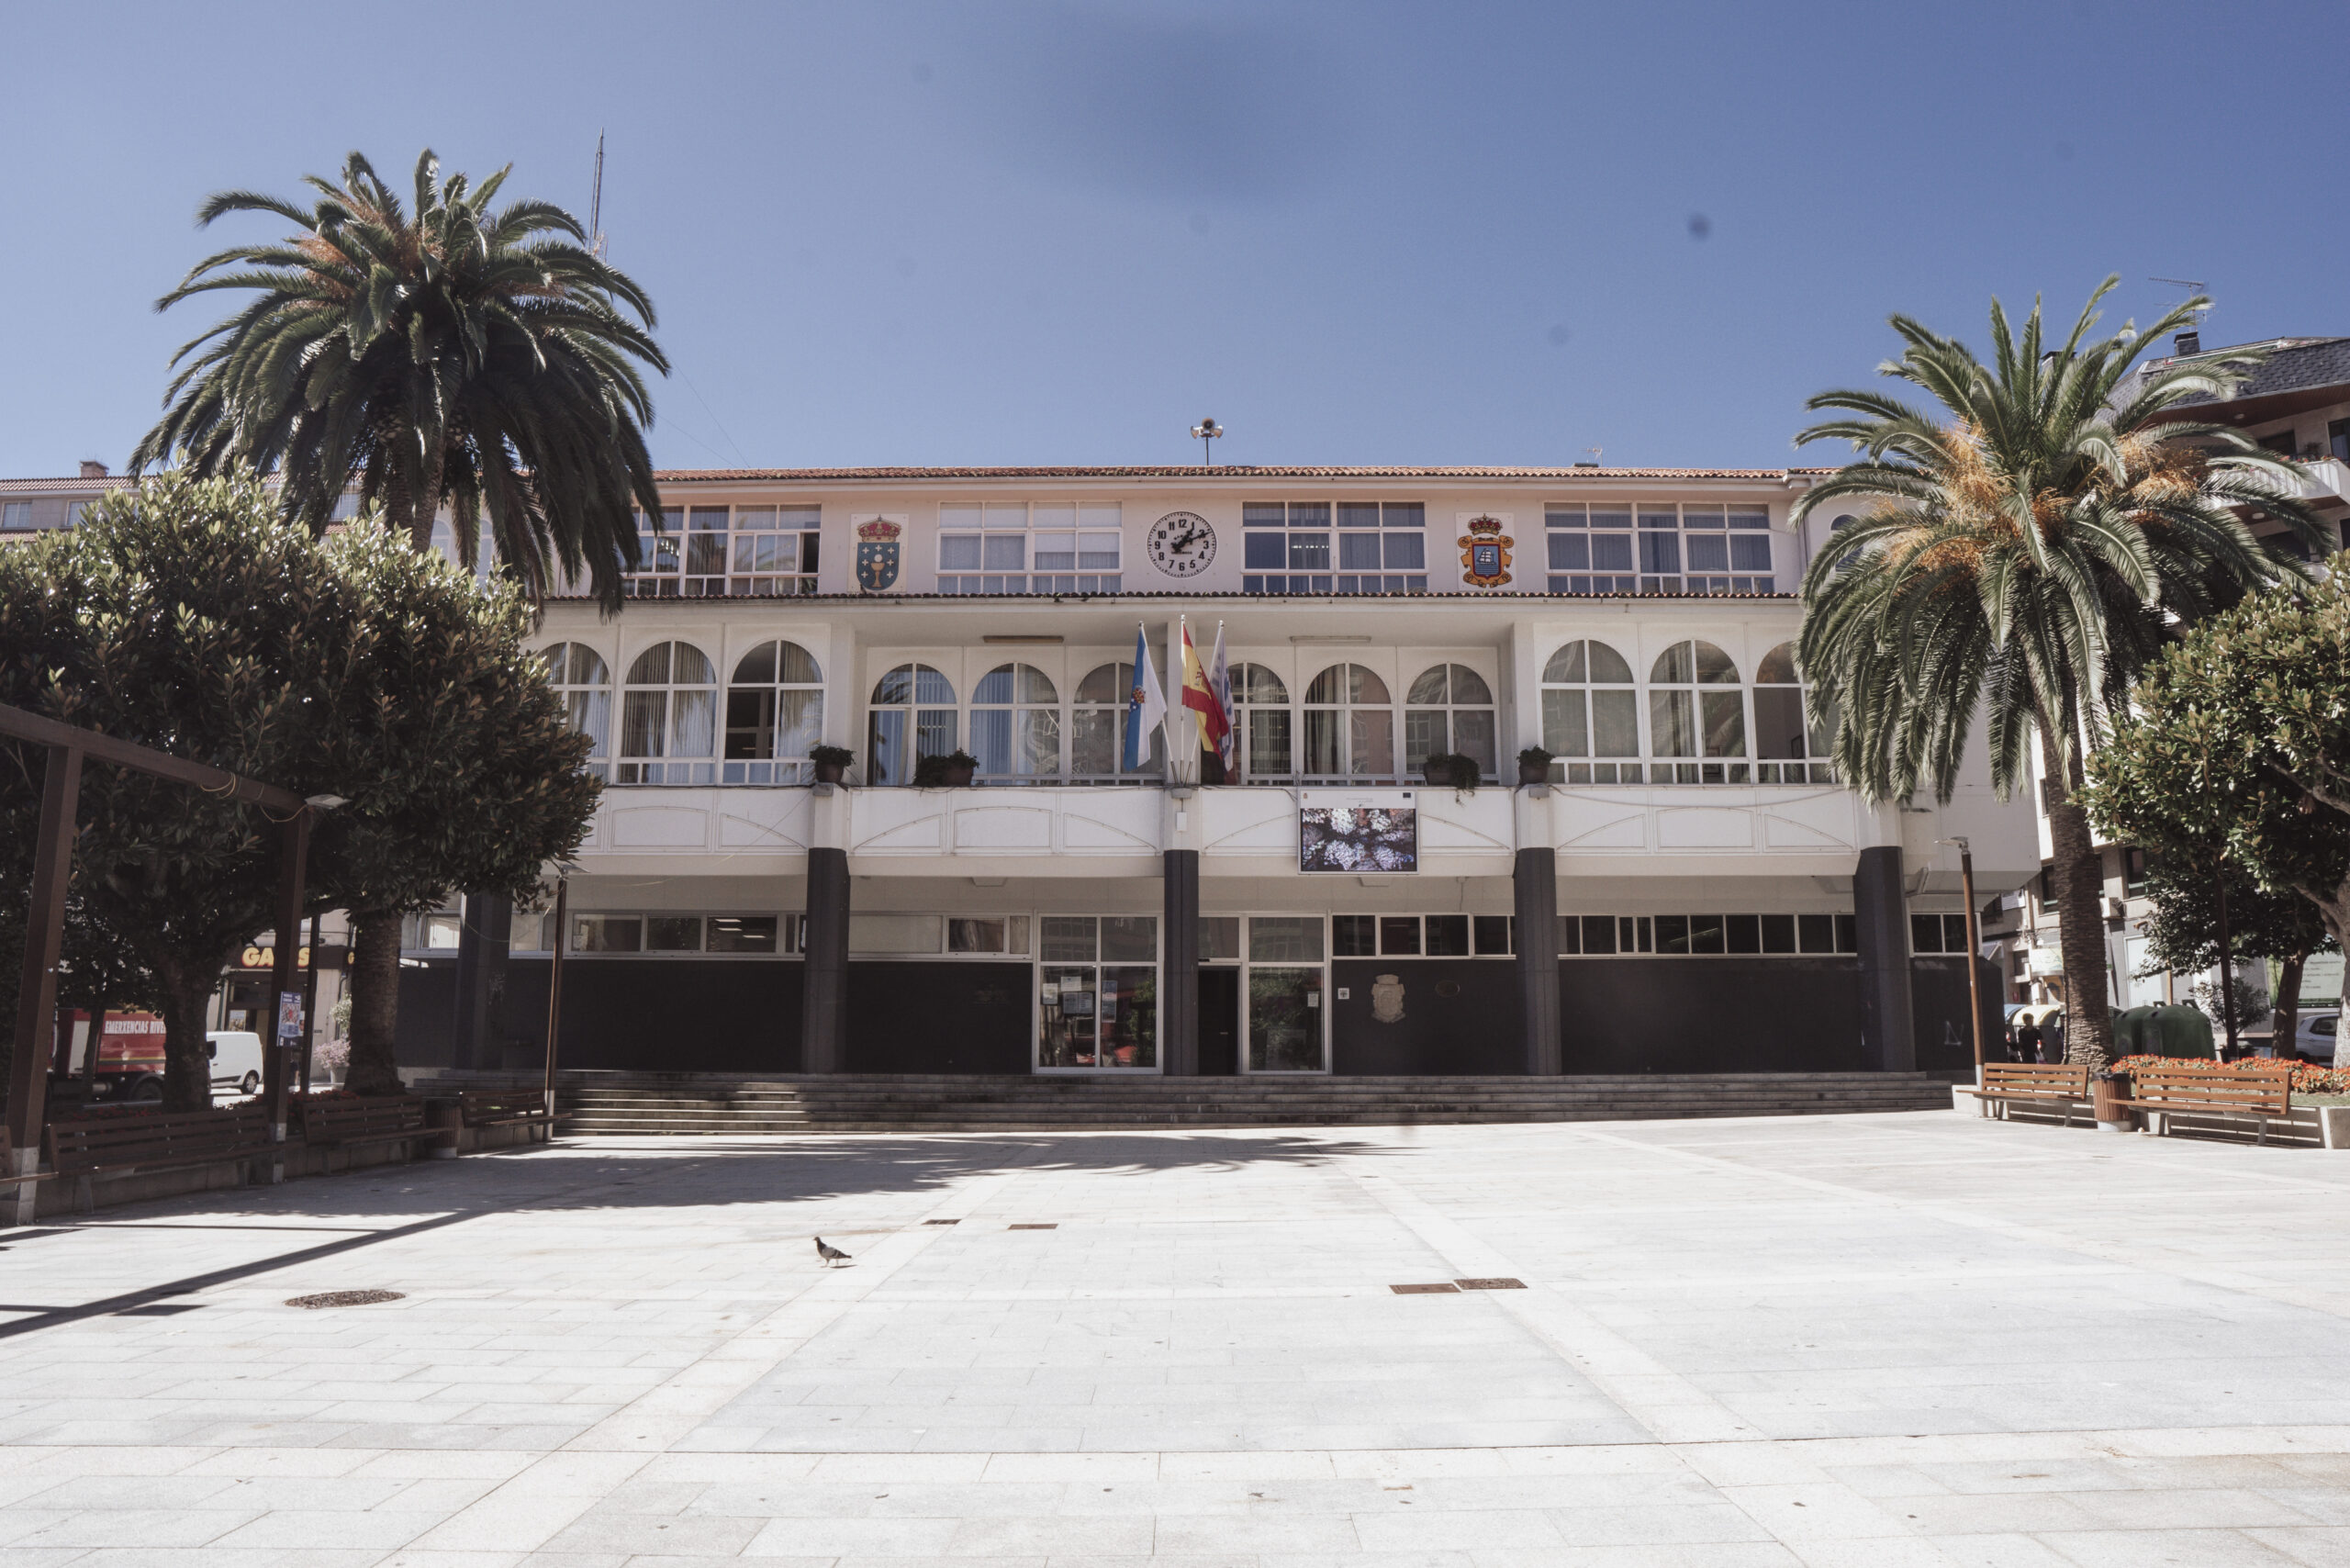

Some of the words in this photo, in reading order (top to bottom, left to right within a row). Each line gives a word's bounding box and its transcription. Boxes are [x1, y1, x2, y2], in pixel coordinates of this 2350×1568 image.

[1169, 521, 1175, 531] 11
[1179, 519, 1187, 528] 12
[1158, 531, 1167, 540] 10
[1155, 541, 1160, 550] 9
[1203, 541, 1209, 550] 3
[1158, 552, 1165, 561] 8
[1198, 551, 1204, 560] 4
[1169, 560, 1175, 569] 7
[1179, 562, 1185, 571] 6
[1190, 560, 1196, 569] 5
[241, 946, 310, 968] GAS
[104, 1020, 149, 1035] EMERXENCIAS
[150, 1020, 166, 1035] RIVE
